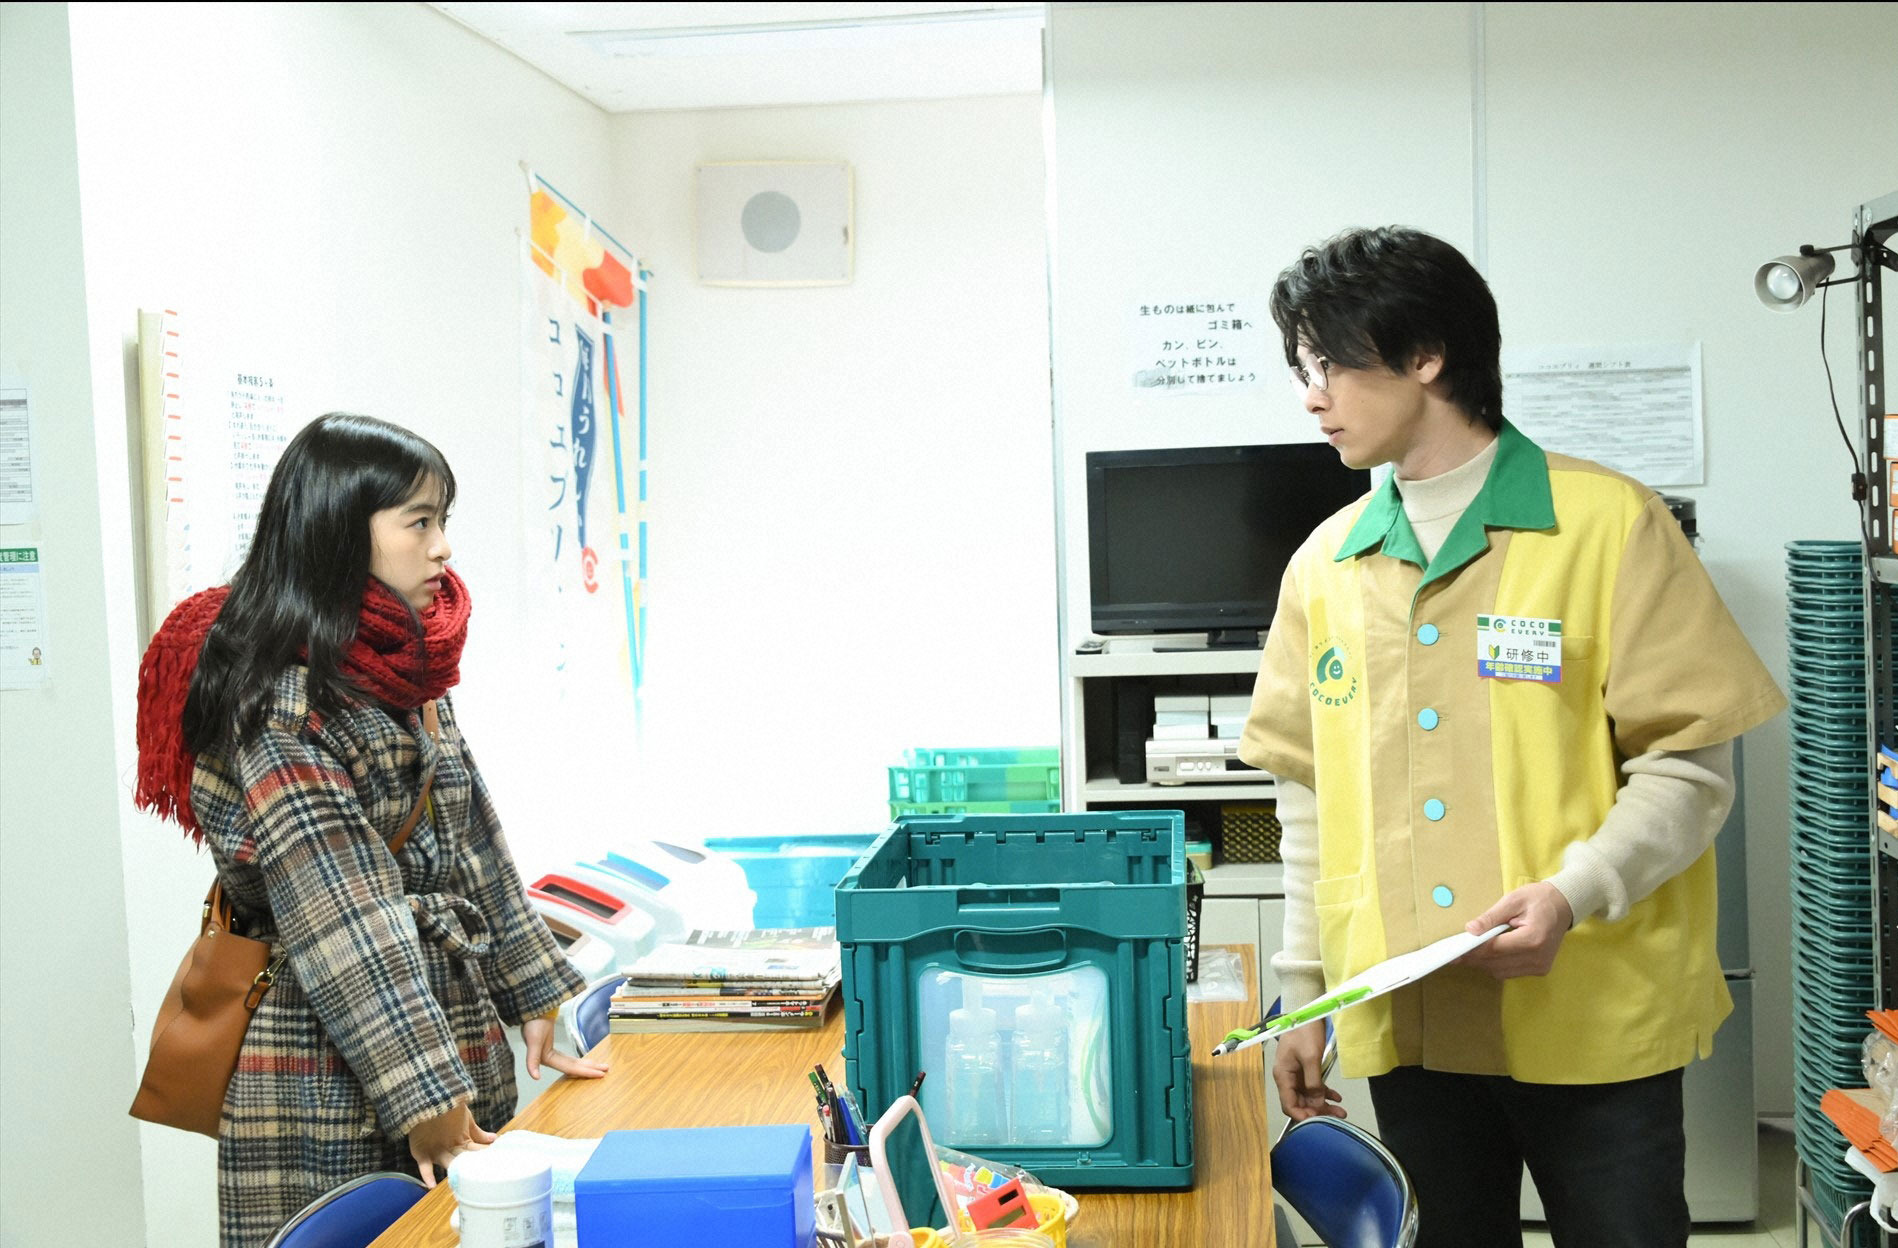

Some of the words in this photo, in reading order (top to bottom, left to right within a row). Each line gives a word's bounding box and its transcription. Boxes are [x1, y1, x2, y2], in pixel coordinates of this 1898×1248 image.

[1140, 303, 1235, 316] 生ものは紙に包んで
[1208, 319, 1253, 331] ゴミ箱へ
[1156, 357, 1236, 369] ペットボトルは
[1156, 373, 1256, 385] 分別して捨てましょう
[1511, 620, 1545, 629] COCO
[1506, 648, 1549, 663] 研修中
[1310, 677, 1357, 706] COCOEVERY
